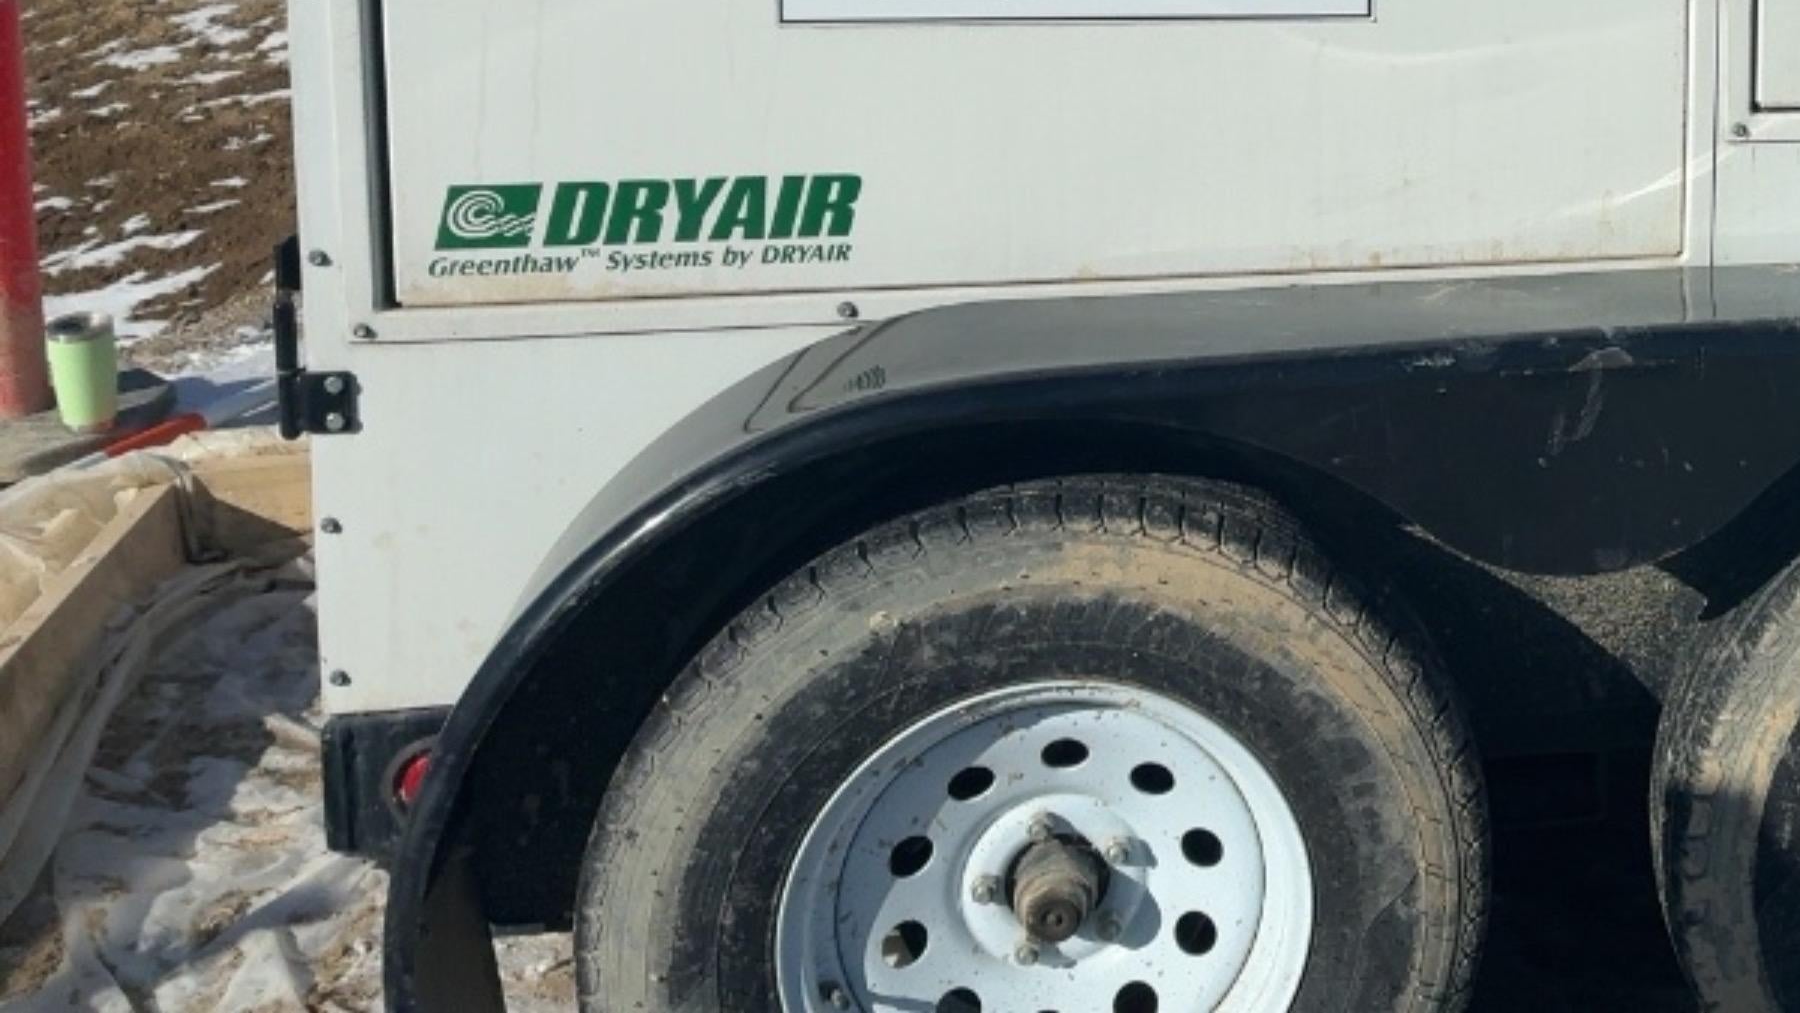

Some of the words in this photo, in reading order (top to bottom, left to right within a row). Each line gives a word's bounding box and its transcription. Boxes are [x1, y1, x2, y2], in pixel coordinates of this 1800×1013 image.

[543, 174, 862, 246] DRYAIR
[606, 248, 713, 272] Systems
[722, 245, 754, 269] by
[761, 243, 853, 265] DRYAIR
